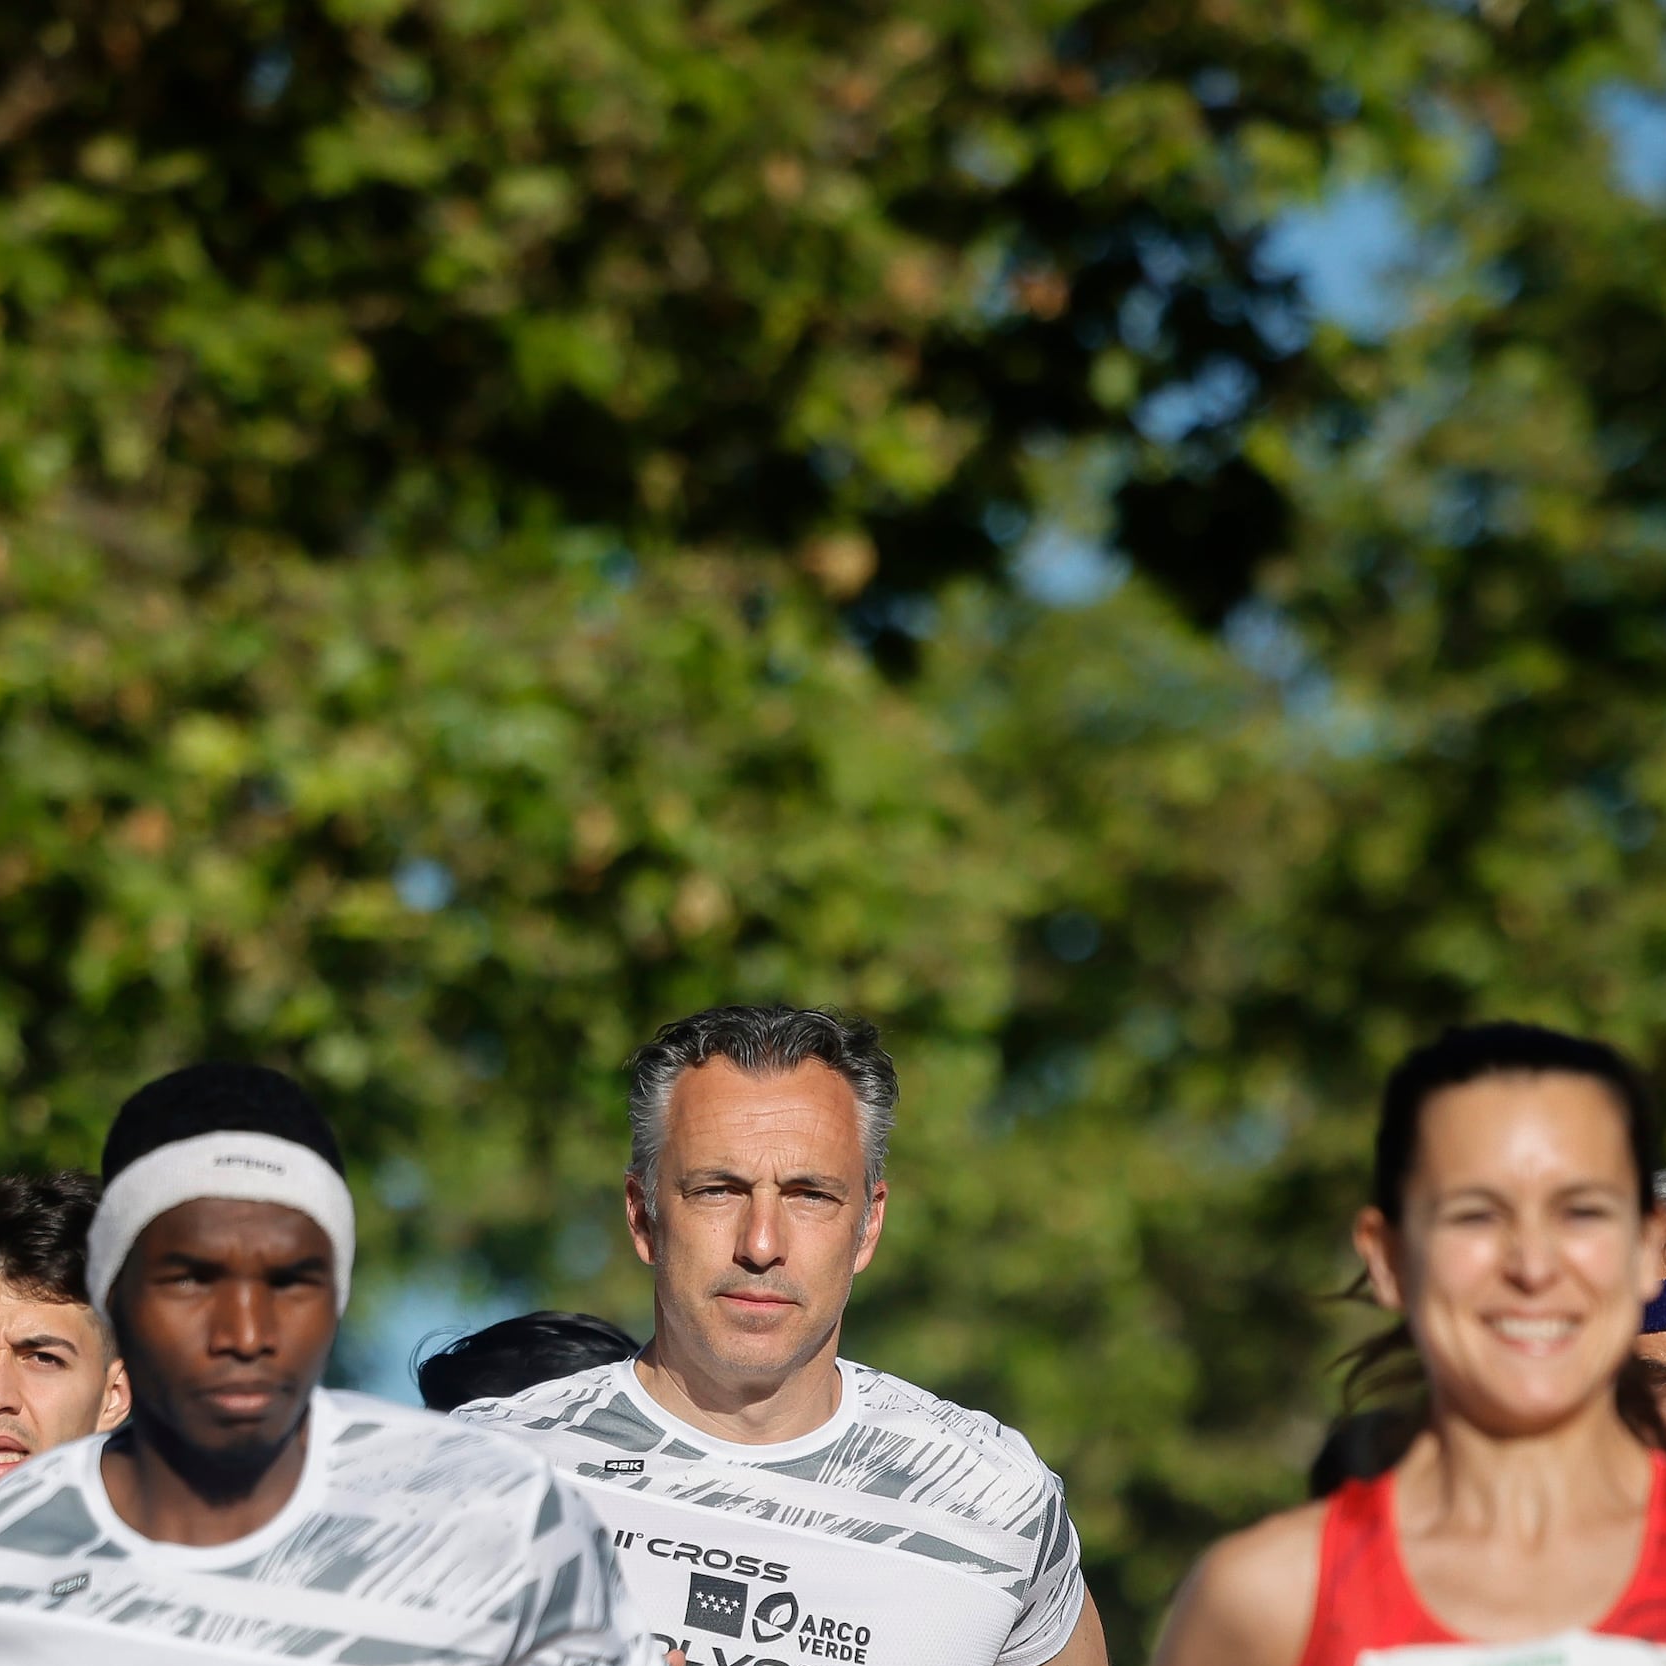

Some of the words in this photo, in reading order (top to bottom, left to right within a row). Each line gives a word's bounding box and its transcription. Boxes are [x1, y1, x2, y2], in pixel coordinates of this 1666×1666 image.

[606, 1461, 643, 1472] 42K
[646, 1537, 791, 1584] CROSS
[799, 1614, 872, 1647] ARCO
[798, 1635, 867, 1666] VERDE
